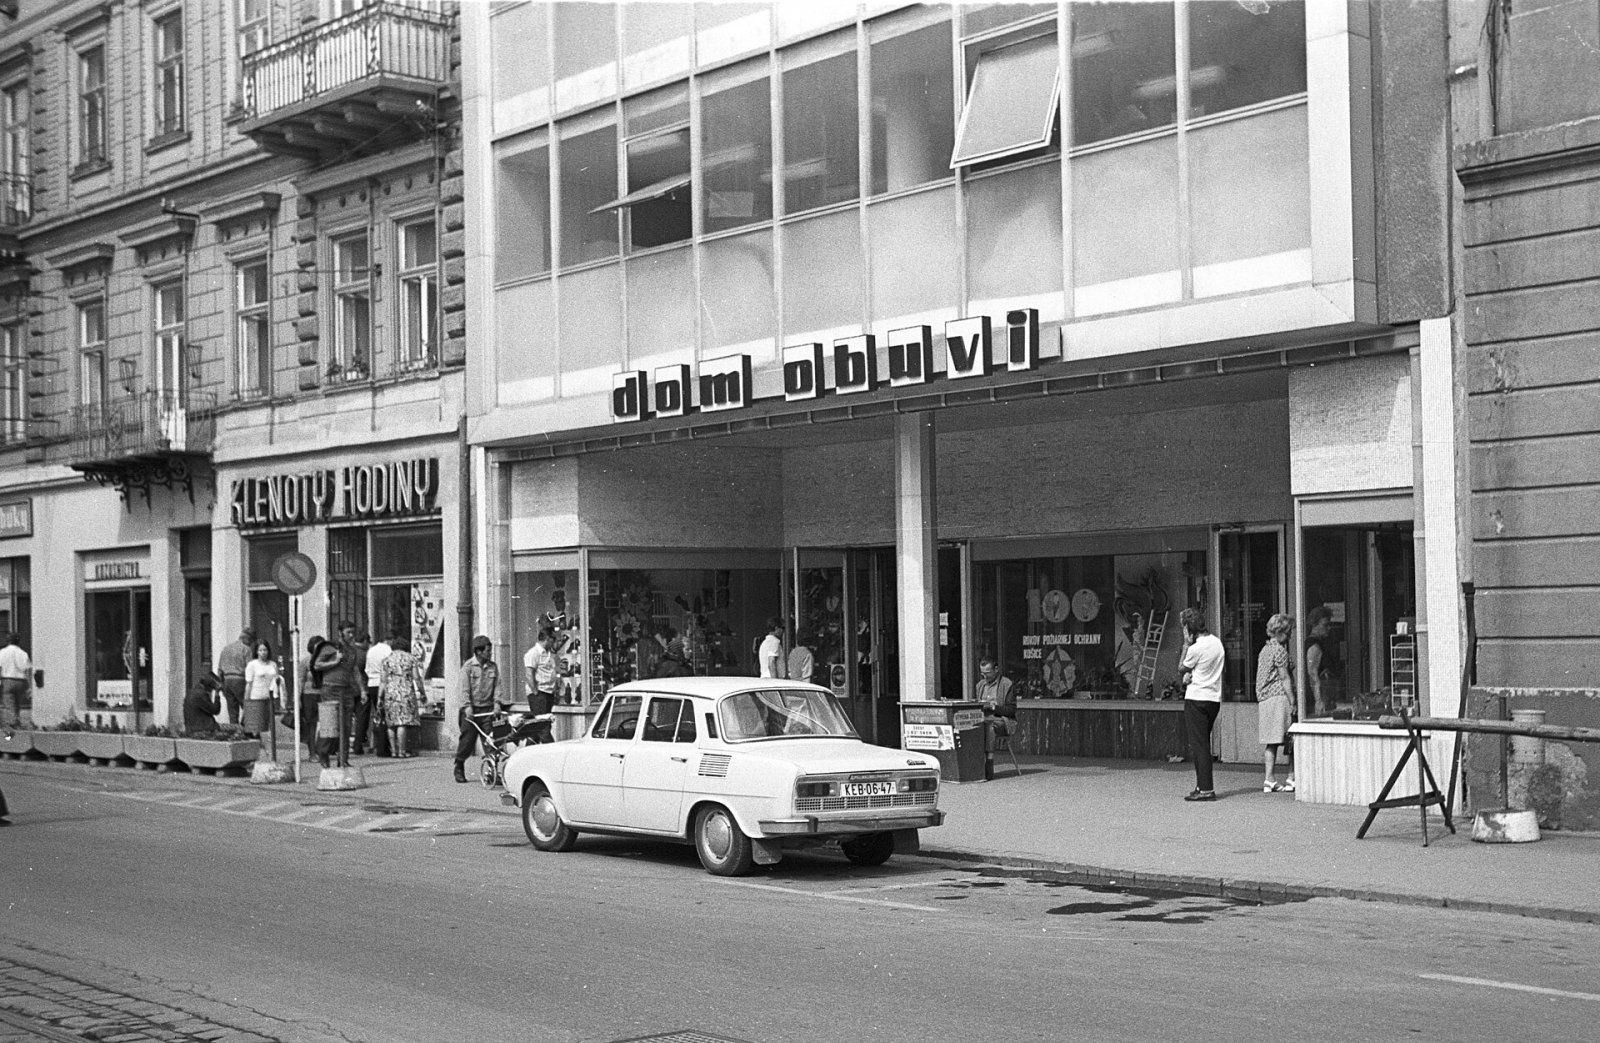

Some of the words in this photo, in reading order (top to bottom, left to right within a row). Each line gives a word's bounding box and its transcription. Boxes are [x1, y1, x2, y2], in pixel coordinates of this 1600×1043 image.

[613, 370, 742, 418] dom
[783, 310, 1028, 394] obuvi
[231, 469, 328, 525] KLENOTY
[342, 459, 432, 517] HODINY
[1026, 588, 1100, 623] 100
